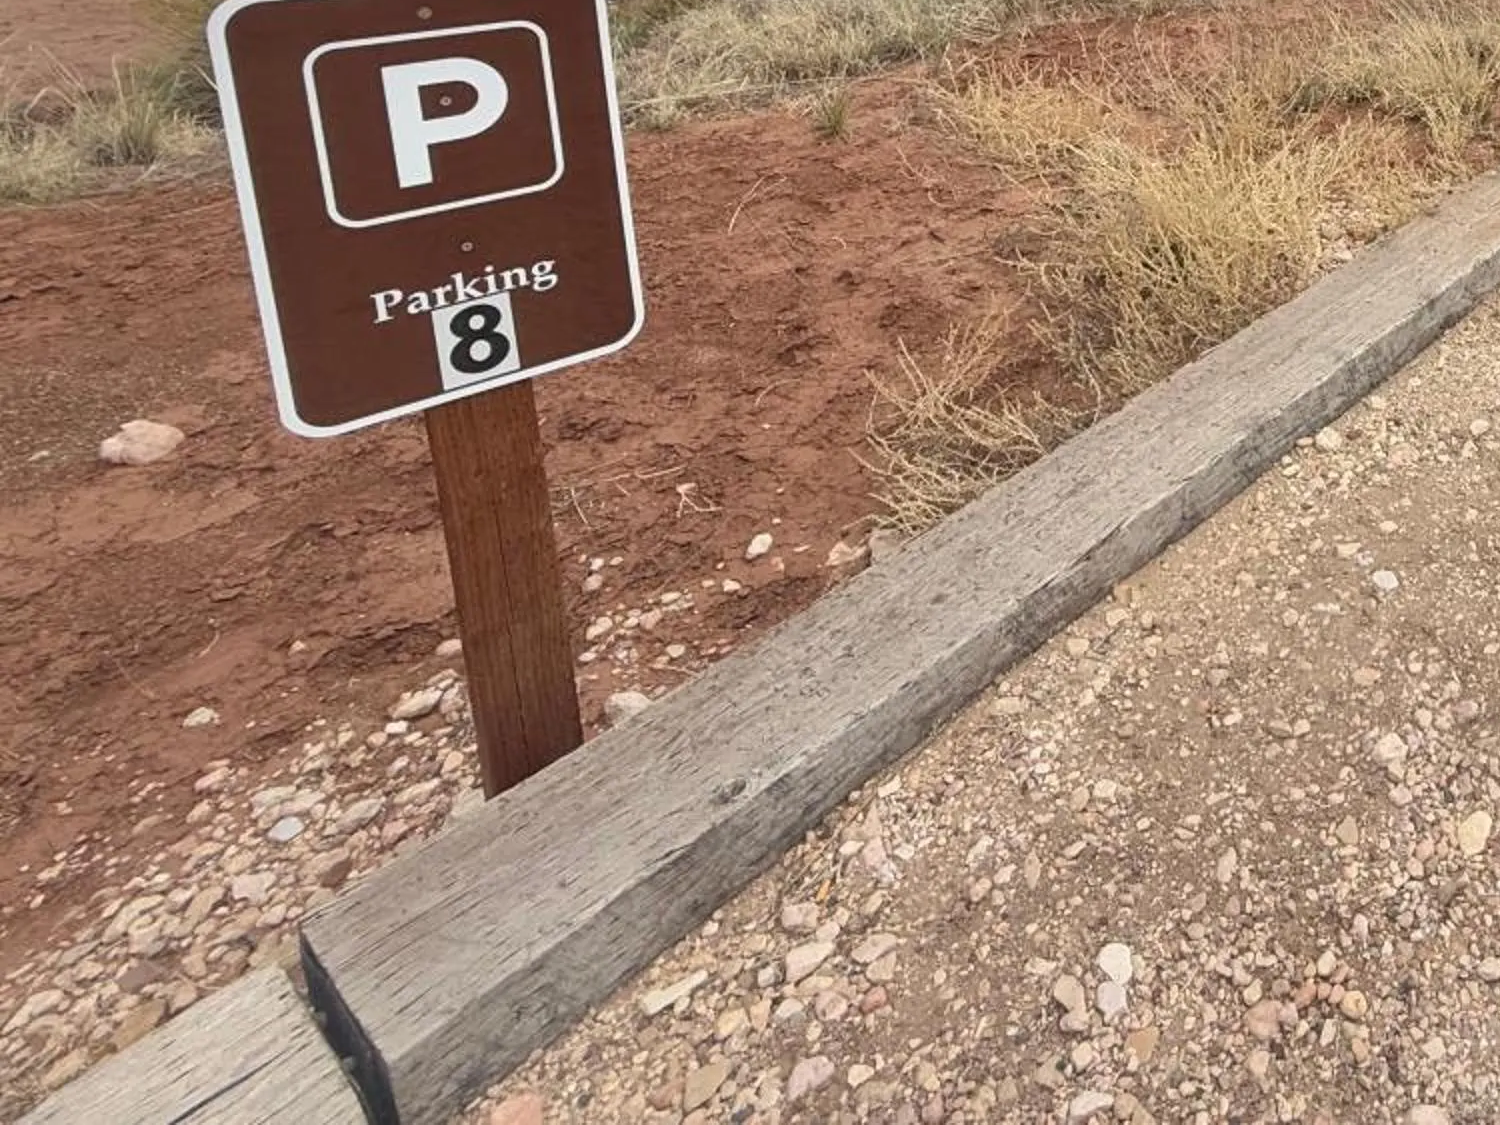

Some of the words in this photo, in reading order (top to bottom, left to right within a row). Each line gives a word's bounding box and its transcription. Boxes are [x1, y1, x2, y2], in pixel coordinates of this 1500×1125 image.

[381, 57, 508, 188] P
[370, 259, 559, 324] Parking
[449, 304, 511, 374] 8
